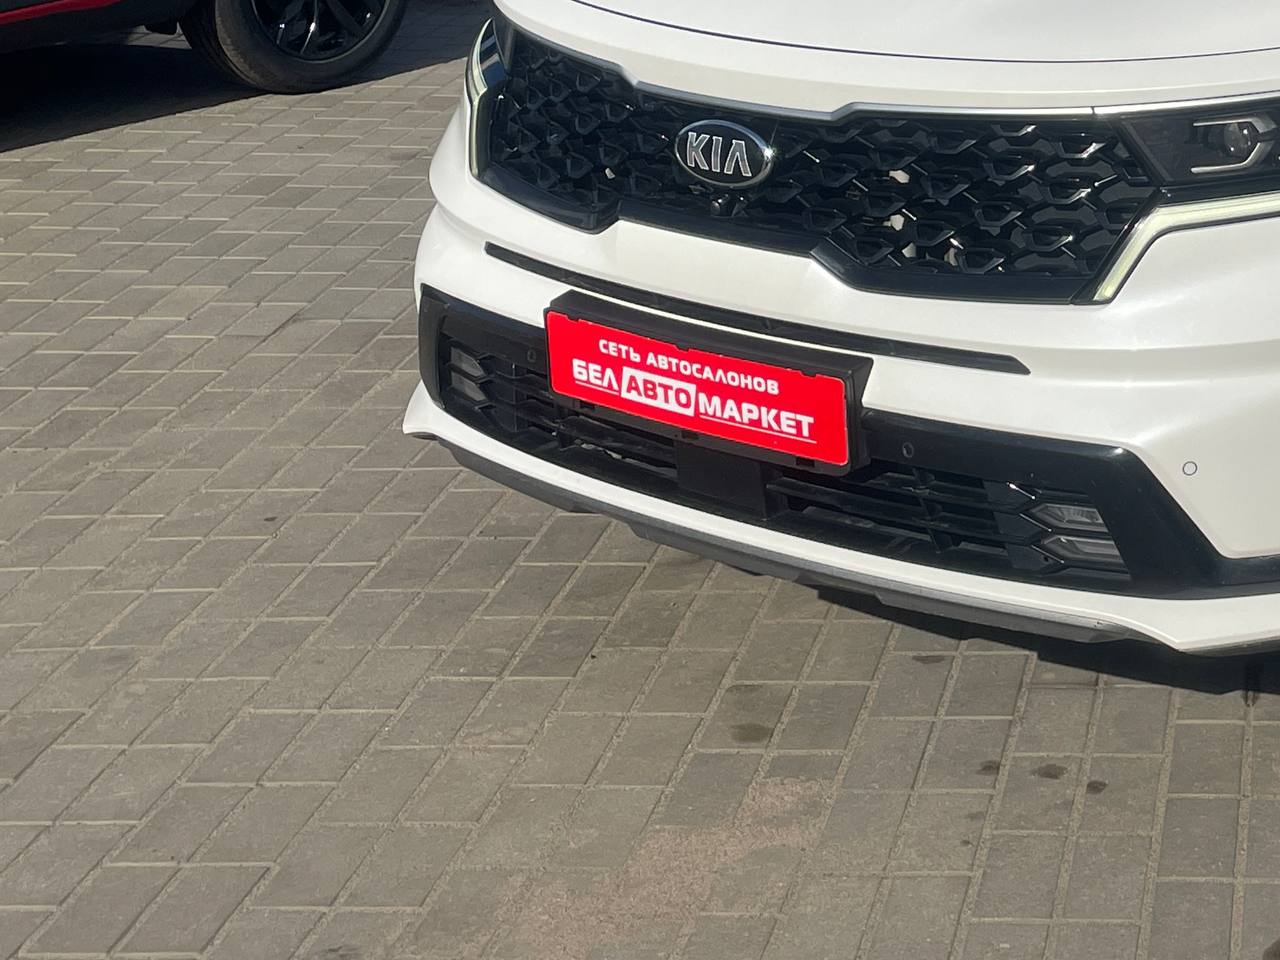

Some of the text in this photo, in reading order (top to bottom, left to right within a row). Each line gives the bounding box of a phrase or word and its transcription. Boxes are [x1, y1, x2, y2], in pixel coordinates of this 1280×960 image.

[686, 131, 752, 177] KIA
[598, 339, 780, 396] СЕТЬ АВТОСАЛОНОВ
[571, 358, 815, 438] БЕЛ АВТО МАРКЕТ
